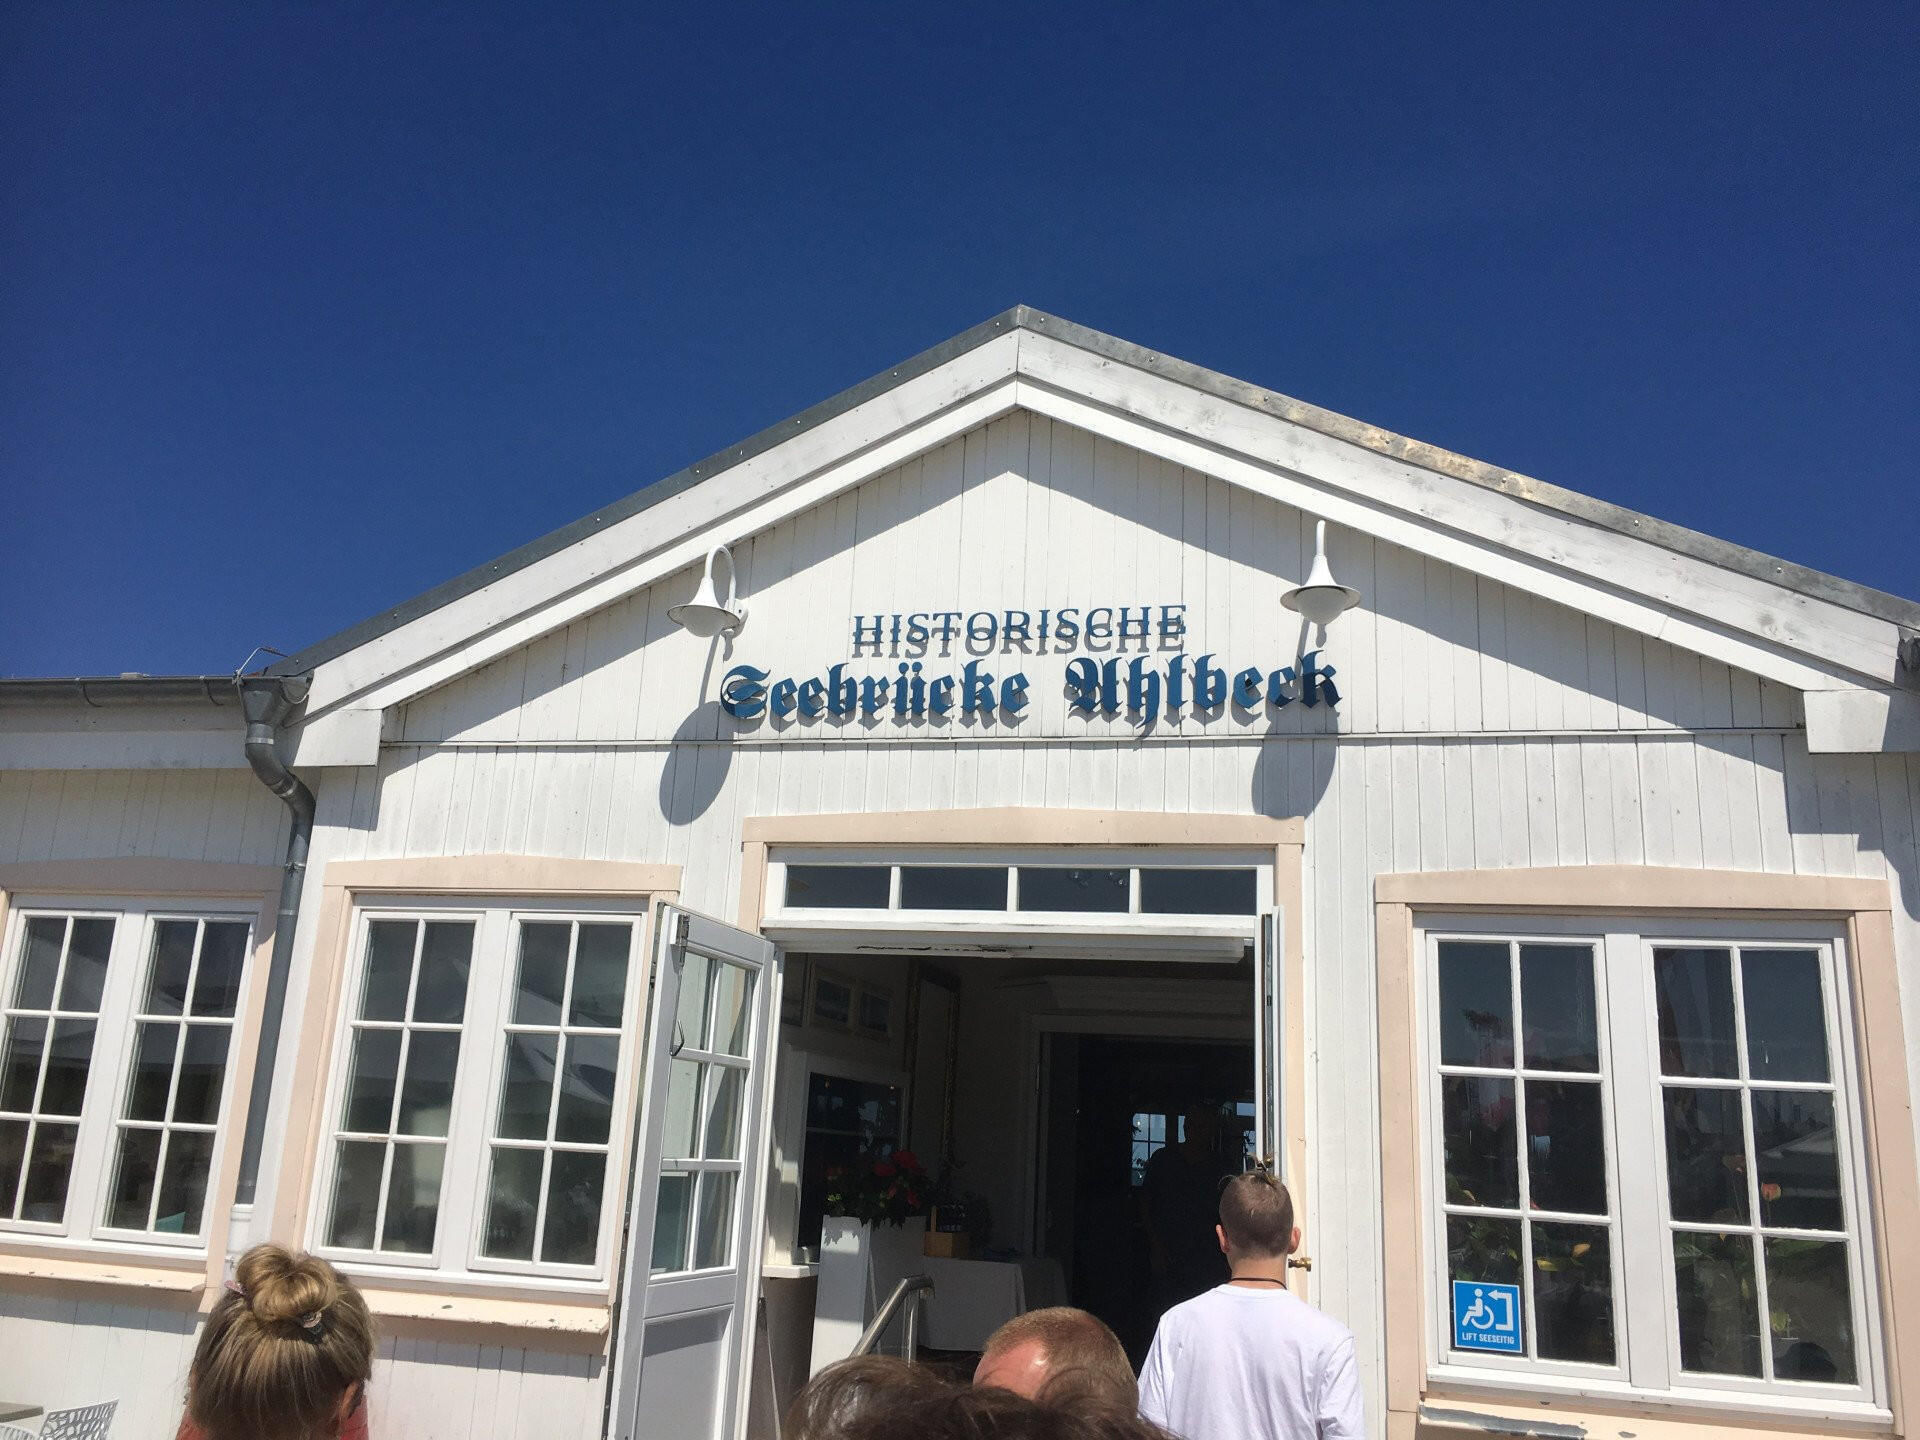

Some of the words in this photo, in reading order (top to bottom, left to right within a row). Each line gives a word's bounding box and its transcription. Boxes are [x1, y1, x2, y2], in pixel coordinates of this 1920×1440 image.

[853, 605, 1187, 644] HISTORISCHE
[721, 659, 1031, 718] Seebrücke
[1066, 651, 1343, 728] Ahlbeck
[1462, 1332, 1477, 1341] LIFT
[1479, 1333, 1514, 1344] SEESEITIG
